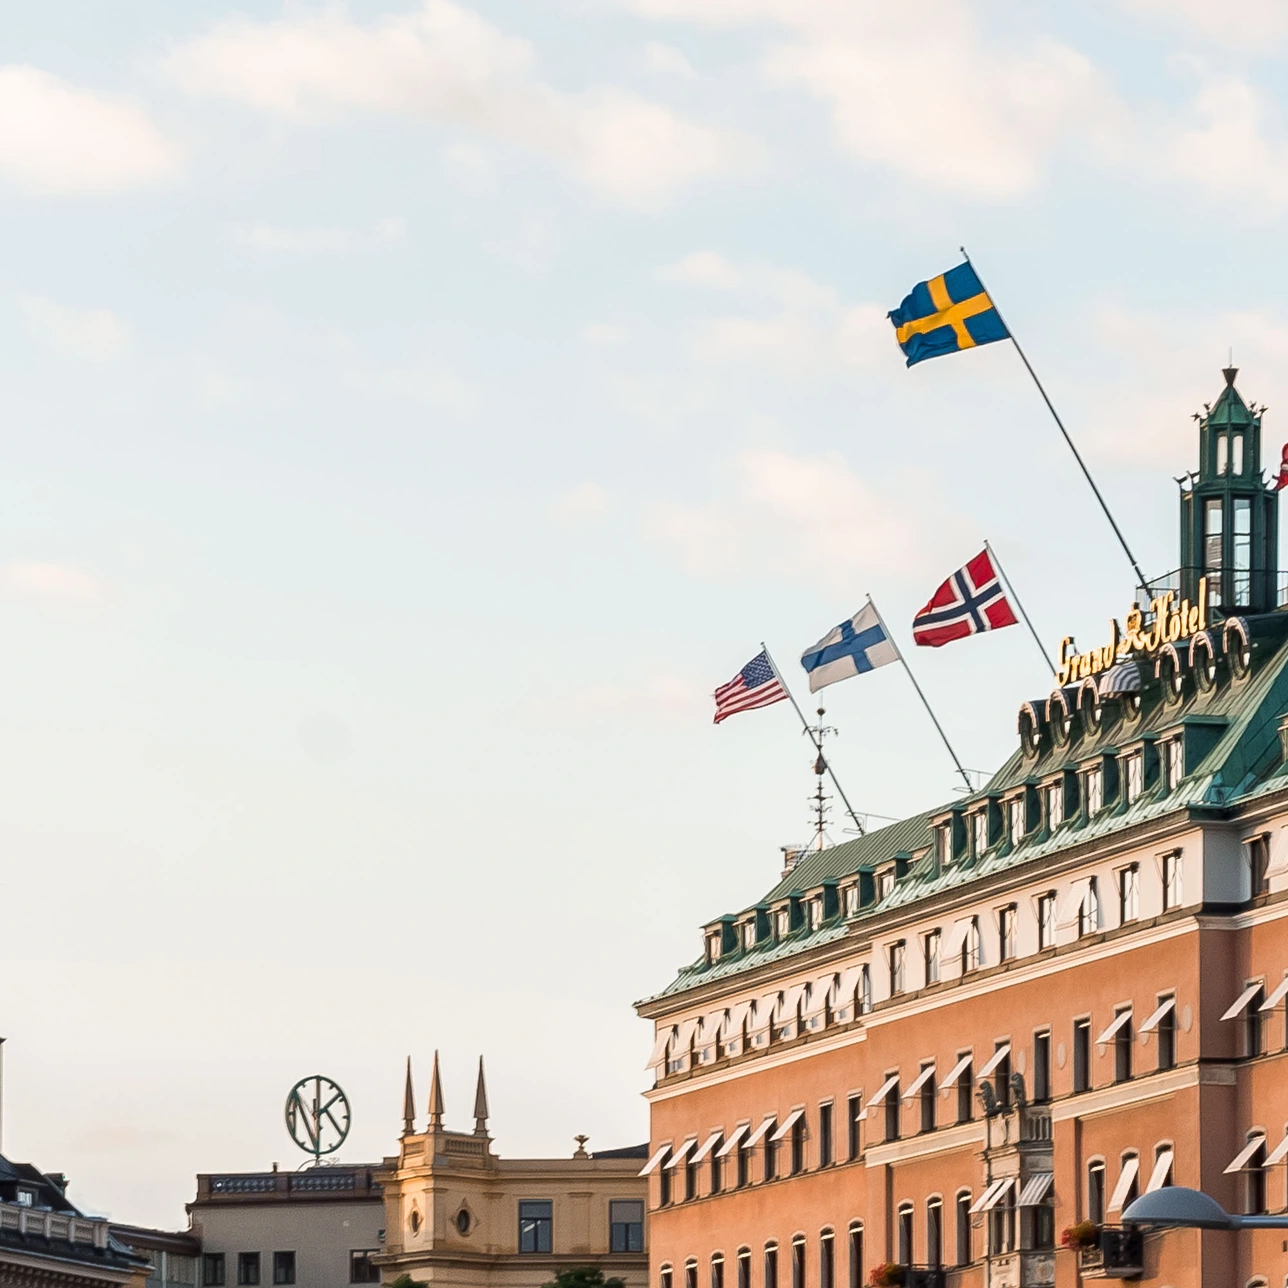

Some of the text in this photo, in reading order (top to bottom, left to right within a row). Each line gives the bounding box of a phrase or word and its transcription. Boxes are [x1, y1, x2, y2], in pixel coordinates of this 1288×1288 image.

[1056, 577, 1208, 687] Grand Hôtel
[288, 1075, 348, 1154] NK
